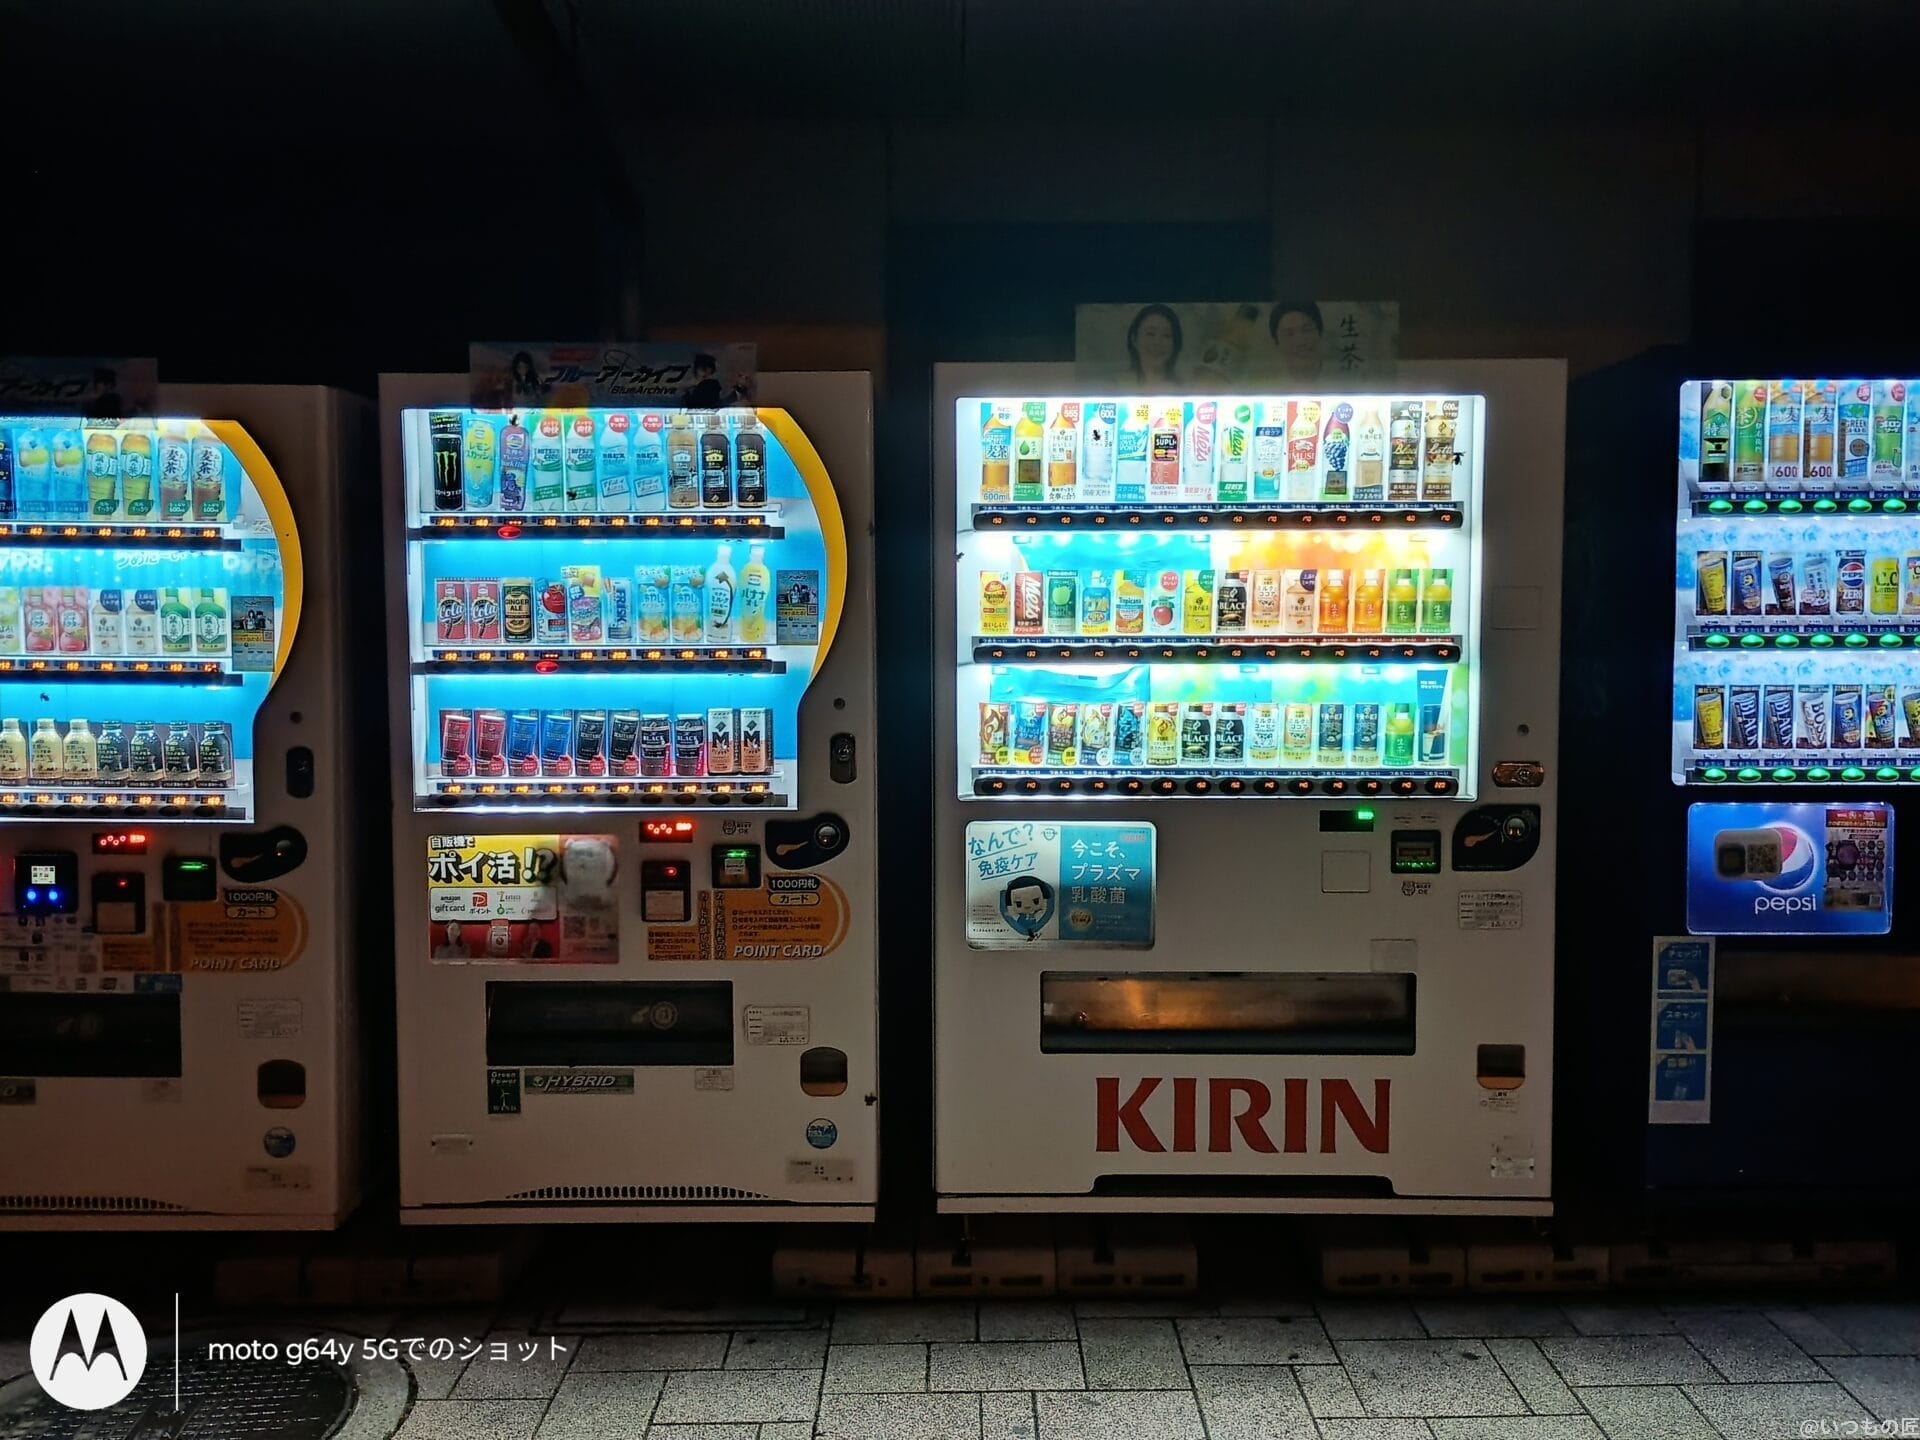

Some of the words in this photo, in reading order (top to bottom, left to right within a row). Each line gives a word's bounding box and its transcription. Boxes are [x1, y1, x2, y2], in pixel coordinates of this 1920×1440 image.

[1340, 315, 1365, 371] 生茶
[1194, 426, 1212, 462] Mets
[1230, 426, 1244, 457] Mets
[616, 588, 627, 625] FRISK
[1024, 576, 1042, 621] Mets
[438, 605, 464, 619] Cola
[472, 605, 497, 619] Cola
[1740, 700, 1758, 746] BLACK
[1775, 700, 1793, 746] BLACK
[1182, 734, 1209, 742] BLACK
[1216, 734, 1243, 742] BLACK
[1071, 839, 1127, 859] 今こそ、
[978, 852, 1038, 877] 免疫ケア
[1071, 863, 1142, 881] プラズマ
[771, 878, 818, 889] 1000円札
[440, 895, 461, 903] amazon
[779, 895, 809, 904] カード
[1071, 886, 1126, 905] 乳酸菌
[1754, 893, 1817, 915] pepsi
[435, 904, 448, 913] gift
[449, 904, 466, 912] card
[734, 945, 780, 957] POINT
[783, 944, 824, 957] CARD
[546, 1075, 617, 1088] HYBRID
[1095, 1077, 1391, 1154] KIRIN
